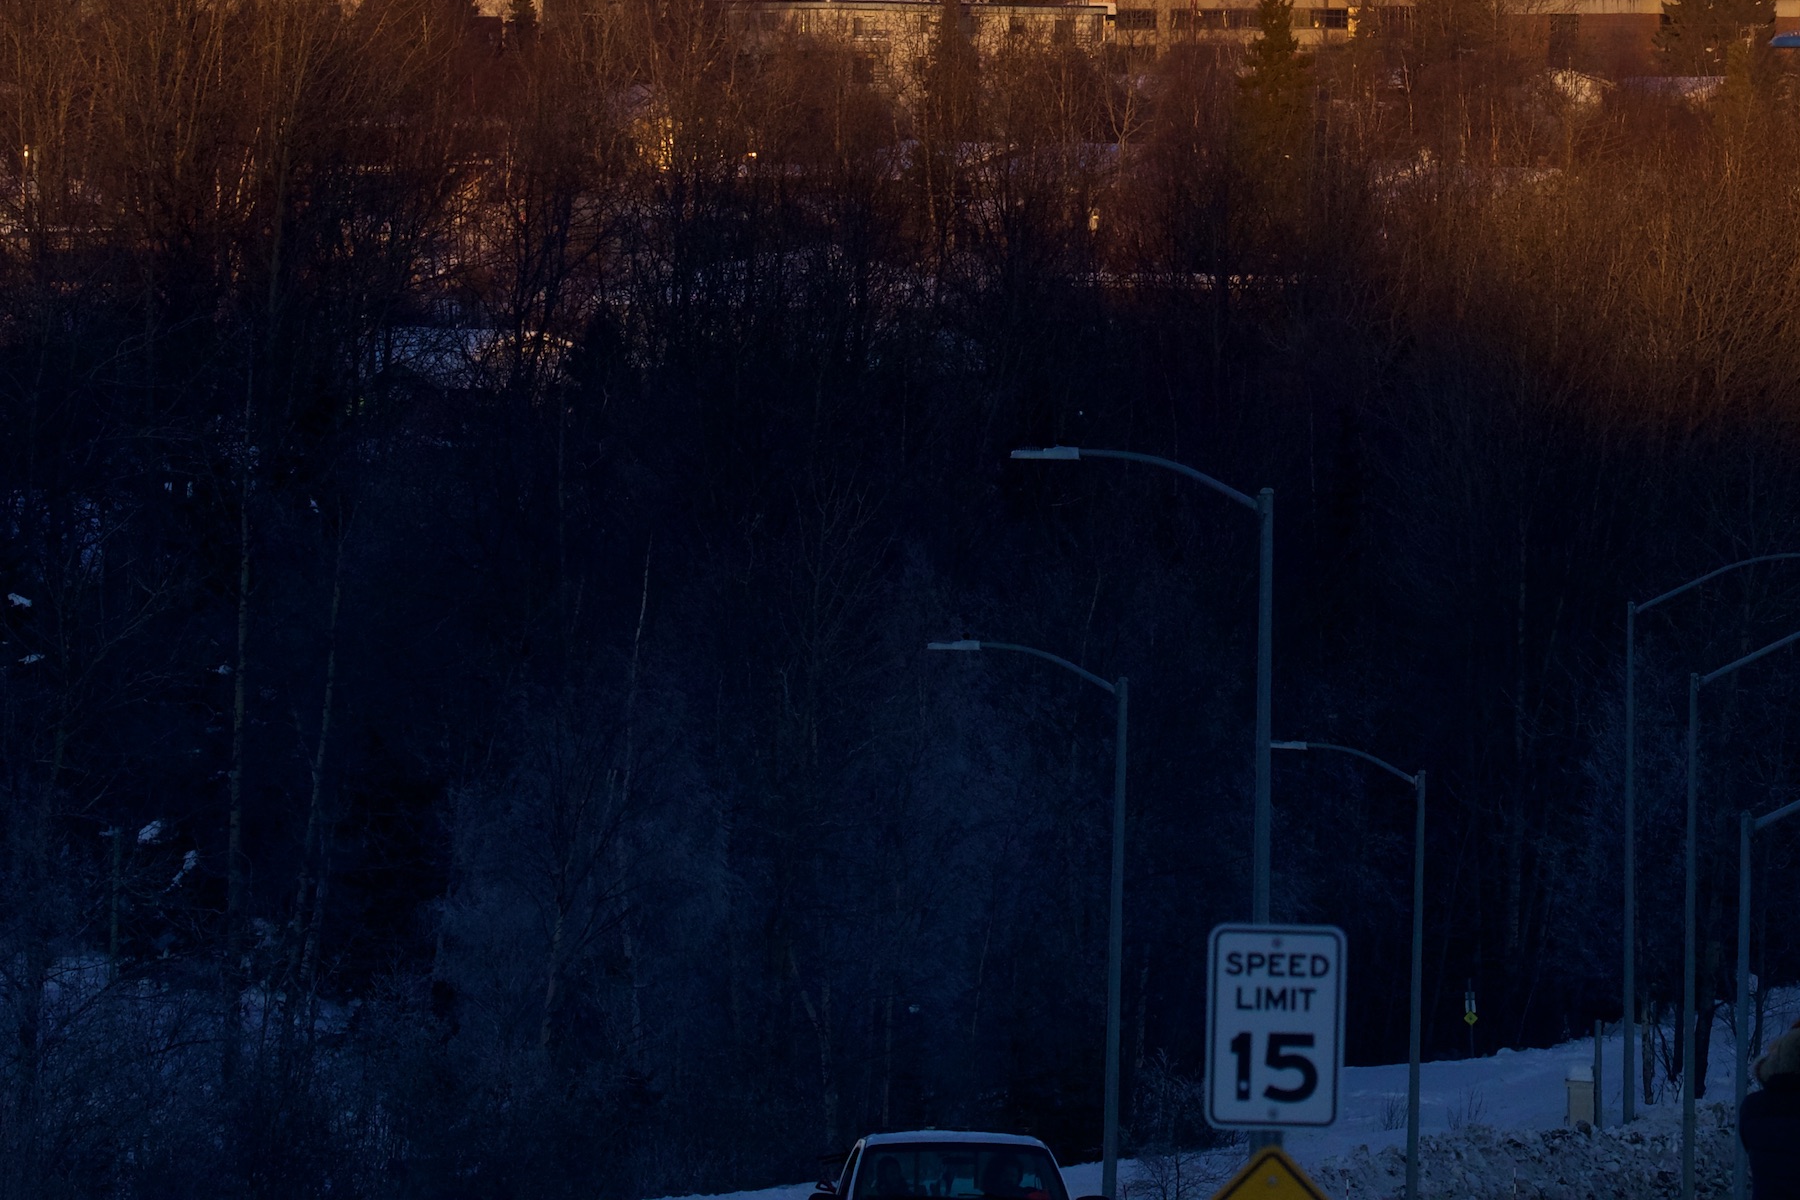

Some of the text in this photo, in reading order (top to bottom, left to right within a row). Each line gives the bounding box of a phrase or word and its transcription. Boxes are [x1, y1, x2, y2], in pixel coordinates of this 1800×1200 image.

[1226, 952, 1330, 978] SPEED
[1235, 987, 1317, 1012] LIMIT
[1230, 1031, 1319, 1104] 15
